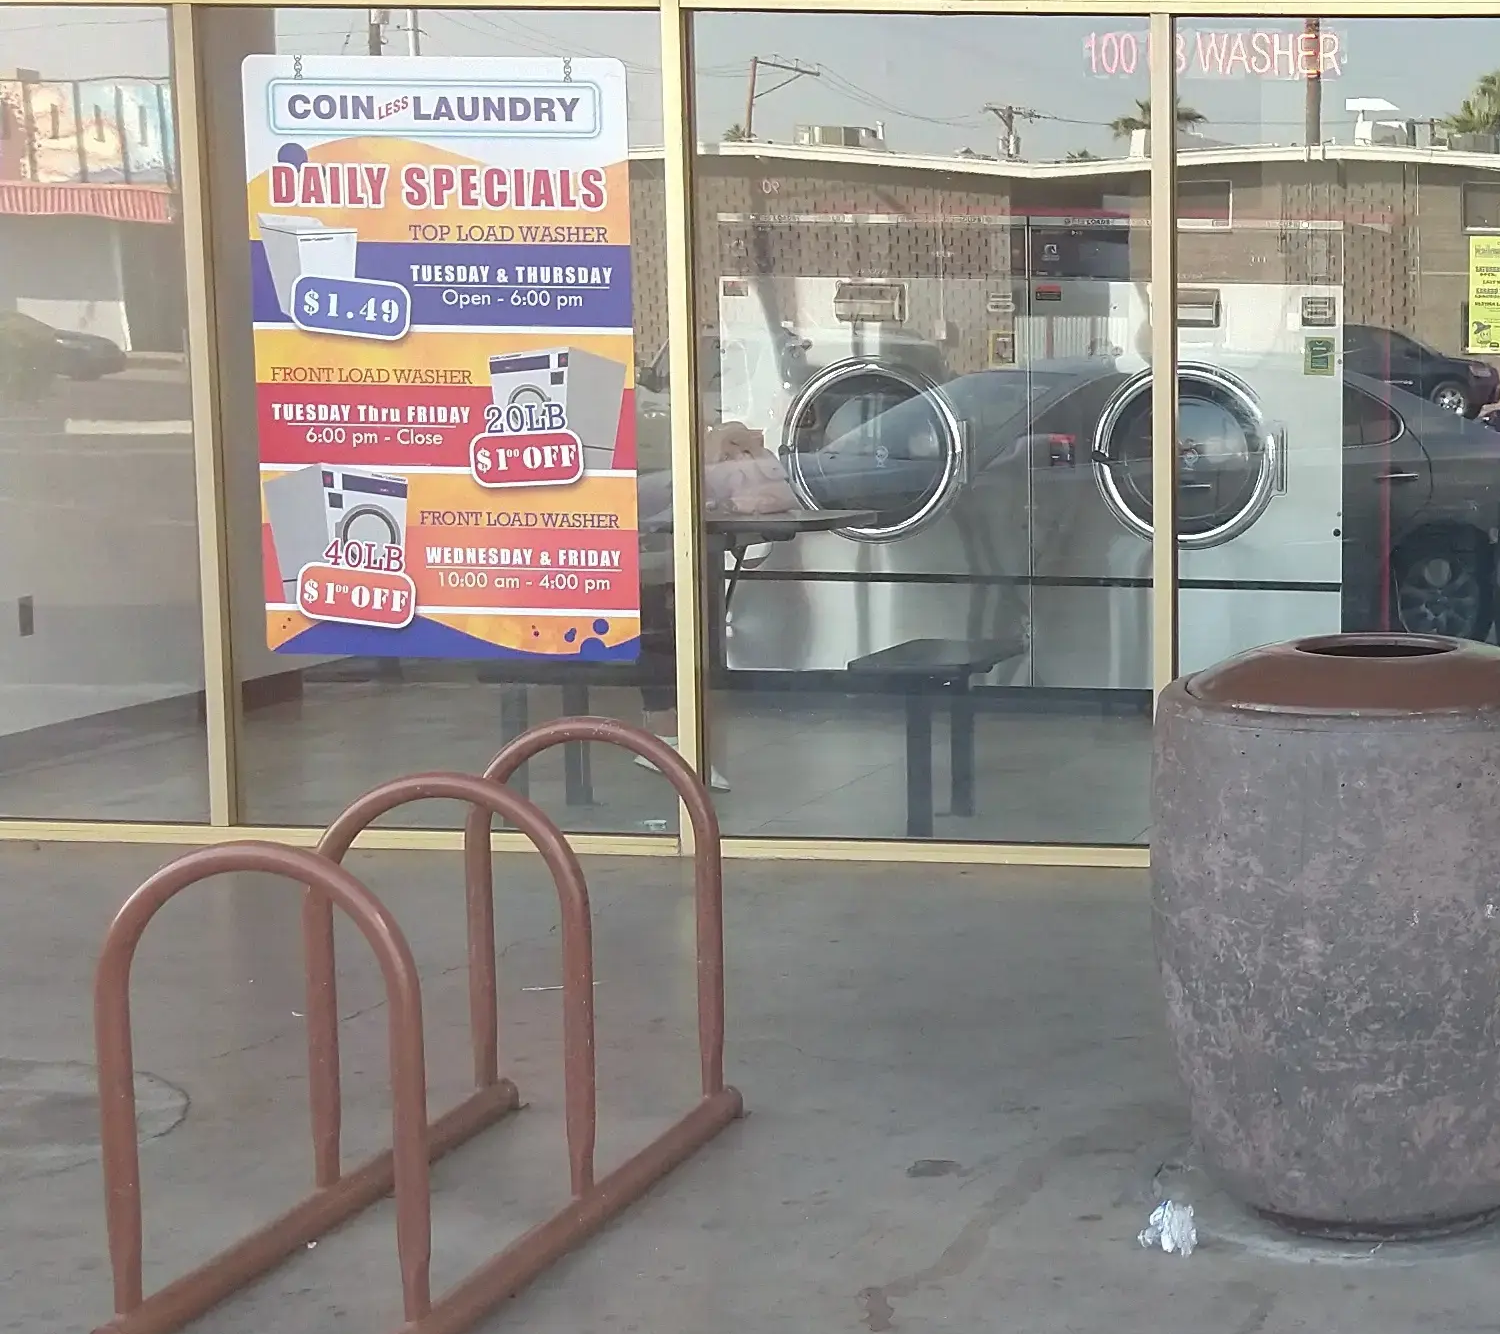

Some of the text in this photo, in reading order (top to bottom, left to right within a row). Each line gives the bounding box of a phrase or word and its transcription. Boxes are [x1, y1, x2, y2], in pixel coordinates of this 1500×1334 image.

[1084, 32, 1138, 74] 100
[1196, 32, 1341, 77] WASHER
[288, 95, 579, 122] COIN LESS LAUNDRY
[271, 165, 605, 209] DAILY SPECIALS
[409, 224, 609, 244] TOP LOAD WASHER
[410, 264, 612, 285] TUESDAY & THURSDAY
[303, 289, 400, 324] $1.49
[442, 289, 491, 308] Open
[510, 289, 551, 308] 6:00
[556, 293, 583, 310] pm
[271, 367, 473, 385] FRONT LOAD WASHER
[272, 403, 470, 425] TUESDAY Thru FRIDAY
[484, 403, 567, 434] 20LB
[306, 428, 346, 445] 6:00
[352, 431, 379, 446] pm
[397, 429, 444, 446] Close
[522, 444, 577, 468] OFF
[420, 511, 620, 529] FRONT LOAD WASHER
[323, 539, 404, 573] 40LB
[425, 547, 622, 567] WEDNESDAY & FRIDAY
[439, 571, 488, 589] 10:00
[495, 574, 520, 589] am
[539, 574, 578, 591] 4:00
[584, 578, 611, 595] pm
[351, 585, 409, 613] OFF
